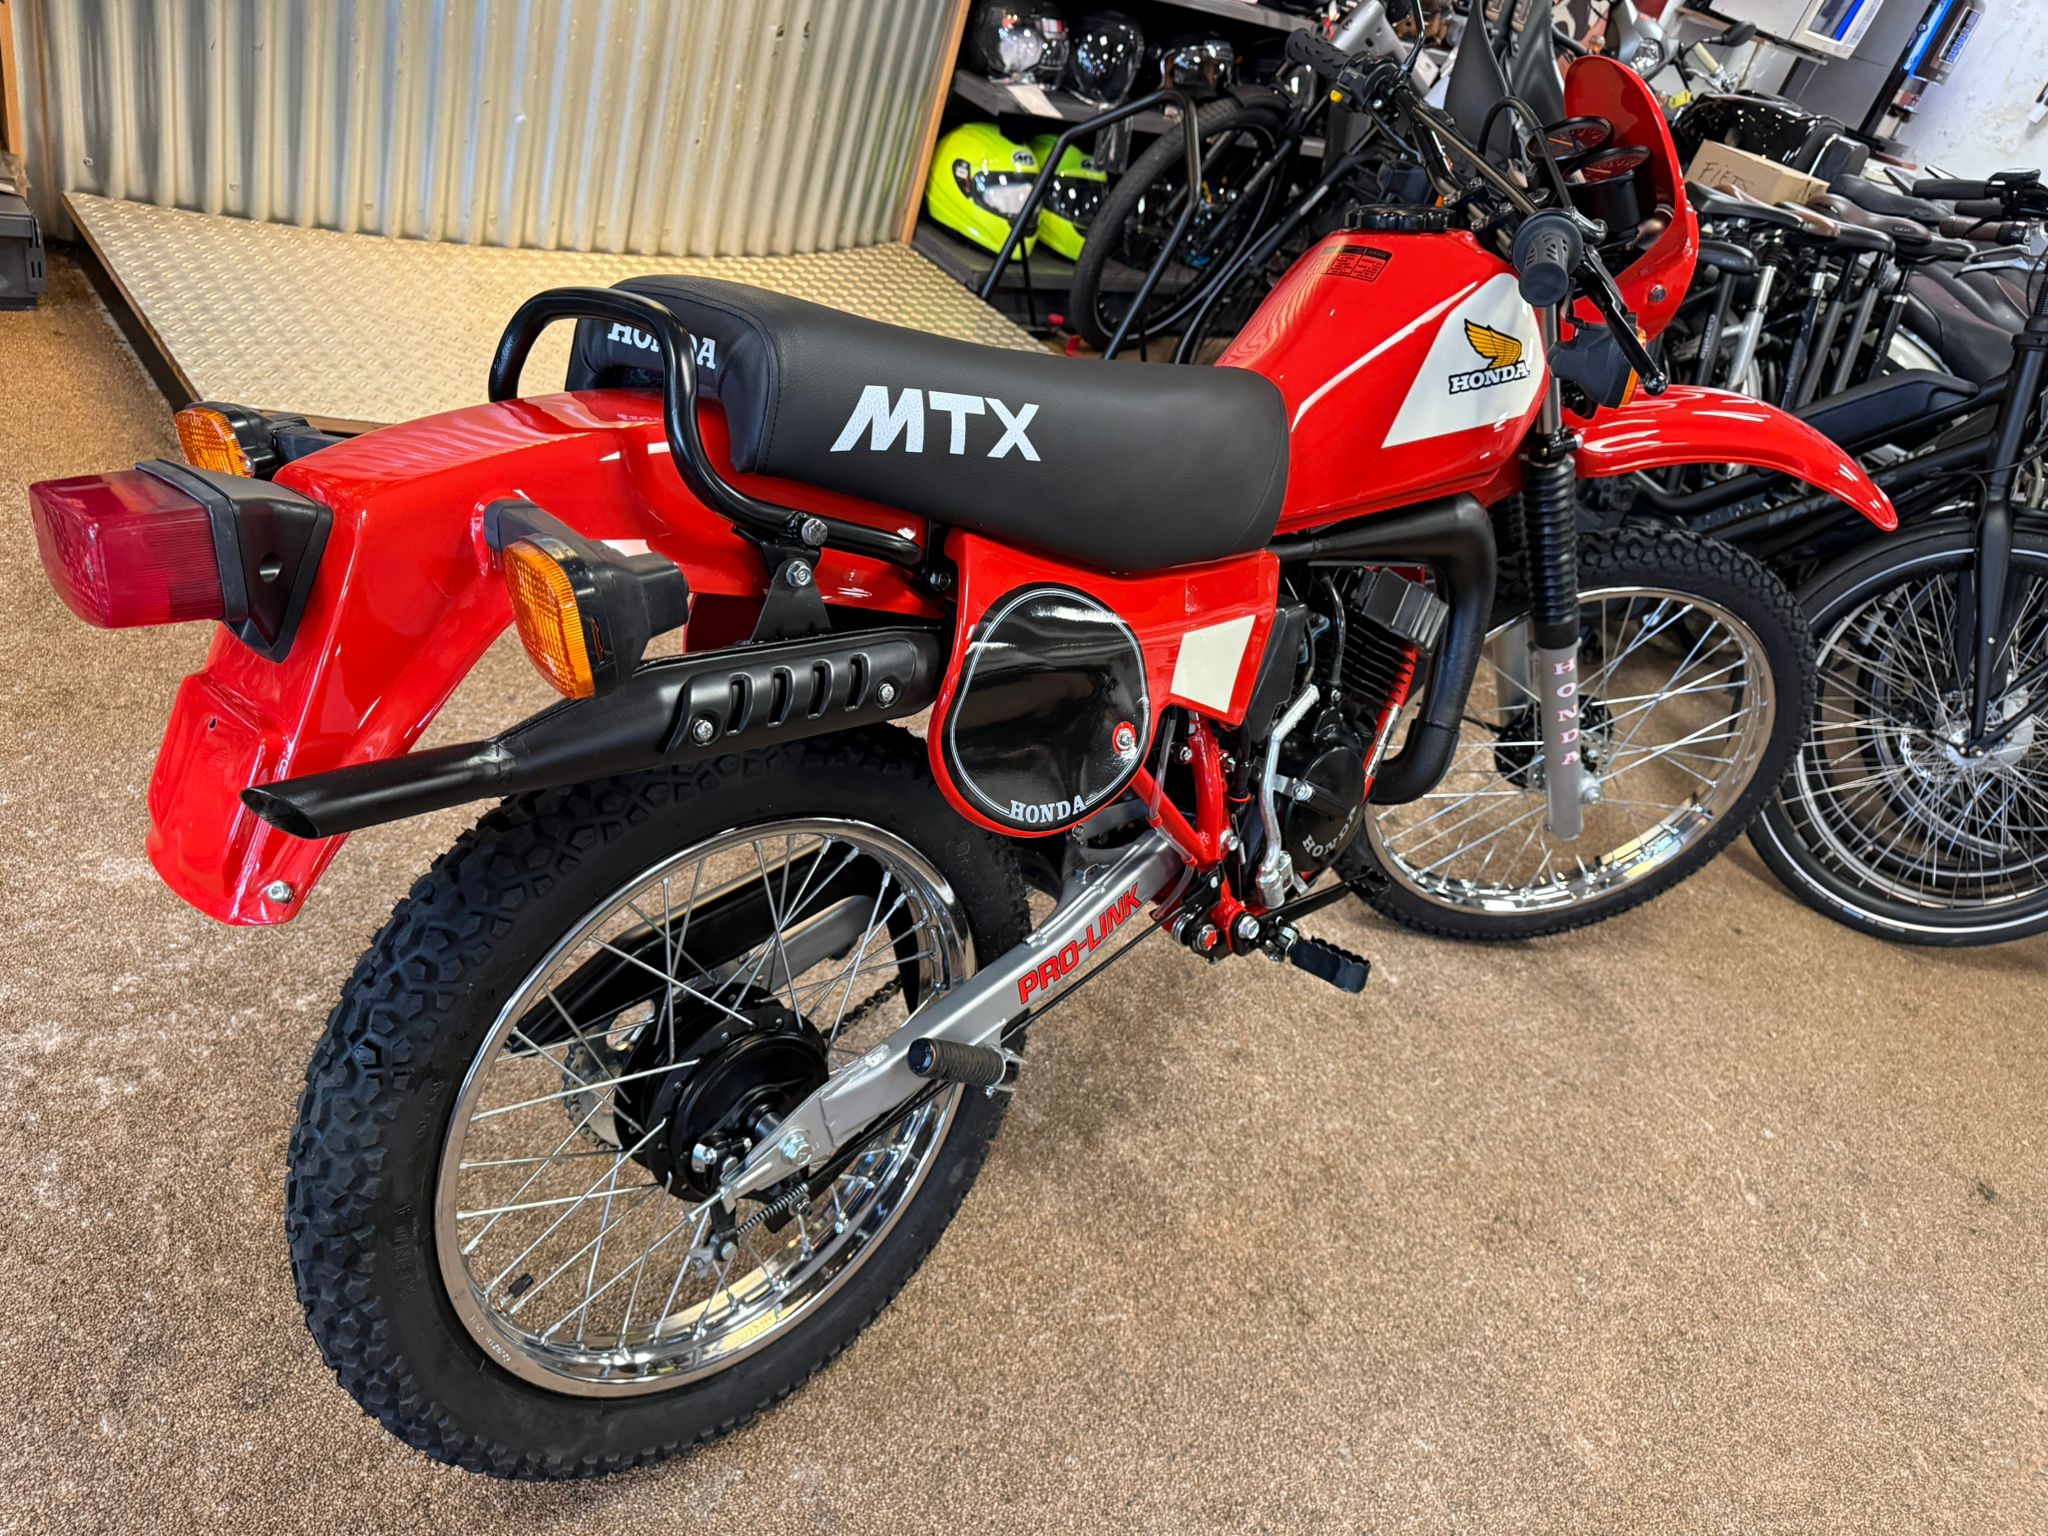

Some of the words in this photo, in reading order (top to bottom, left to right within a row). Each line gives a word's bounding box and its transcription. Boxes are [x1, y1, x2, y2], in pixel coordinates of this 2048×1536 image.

[607, 322, 716, 369] HOA
[1449, 361, 1530, 394] HONDA
[830, 385, 1041, 461] MTX
[1553, 656, 1580, 766] HONDA
[1009, 795, 1086, 824] HONDA
[1017, 882, 1142, 1004] PRO-LINK
